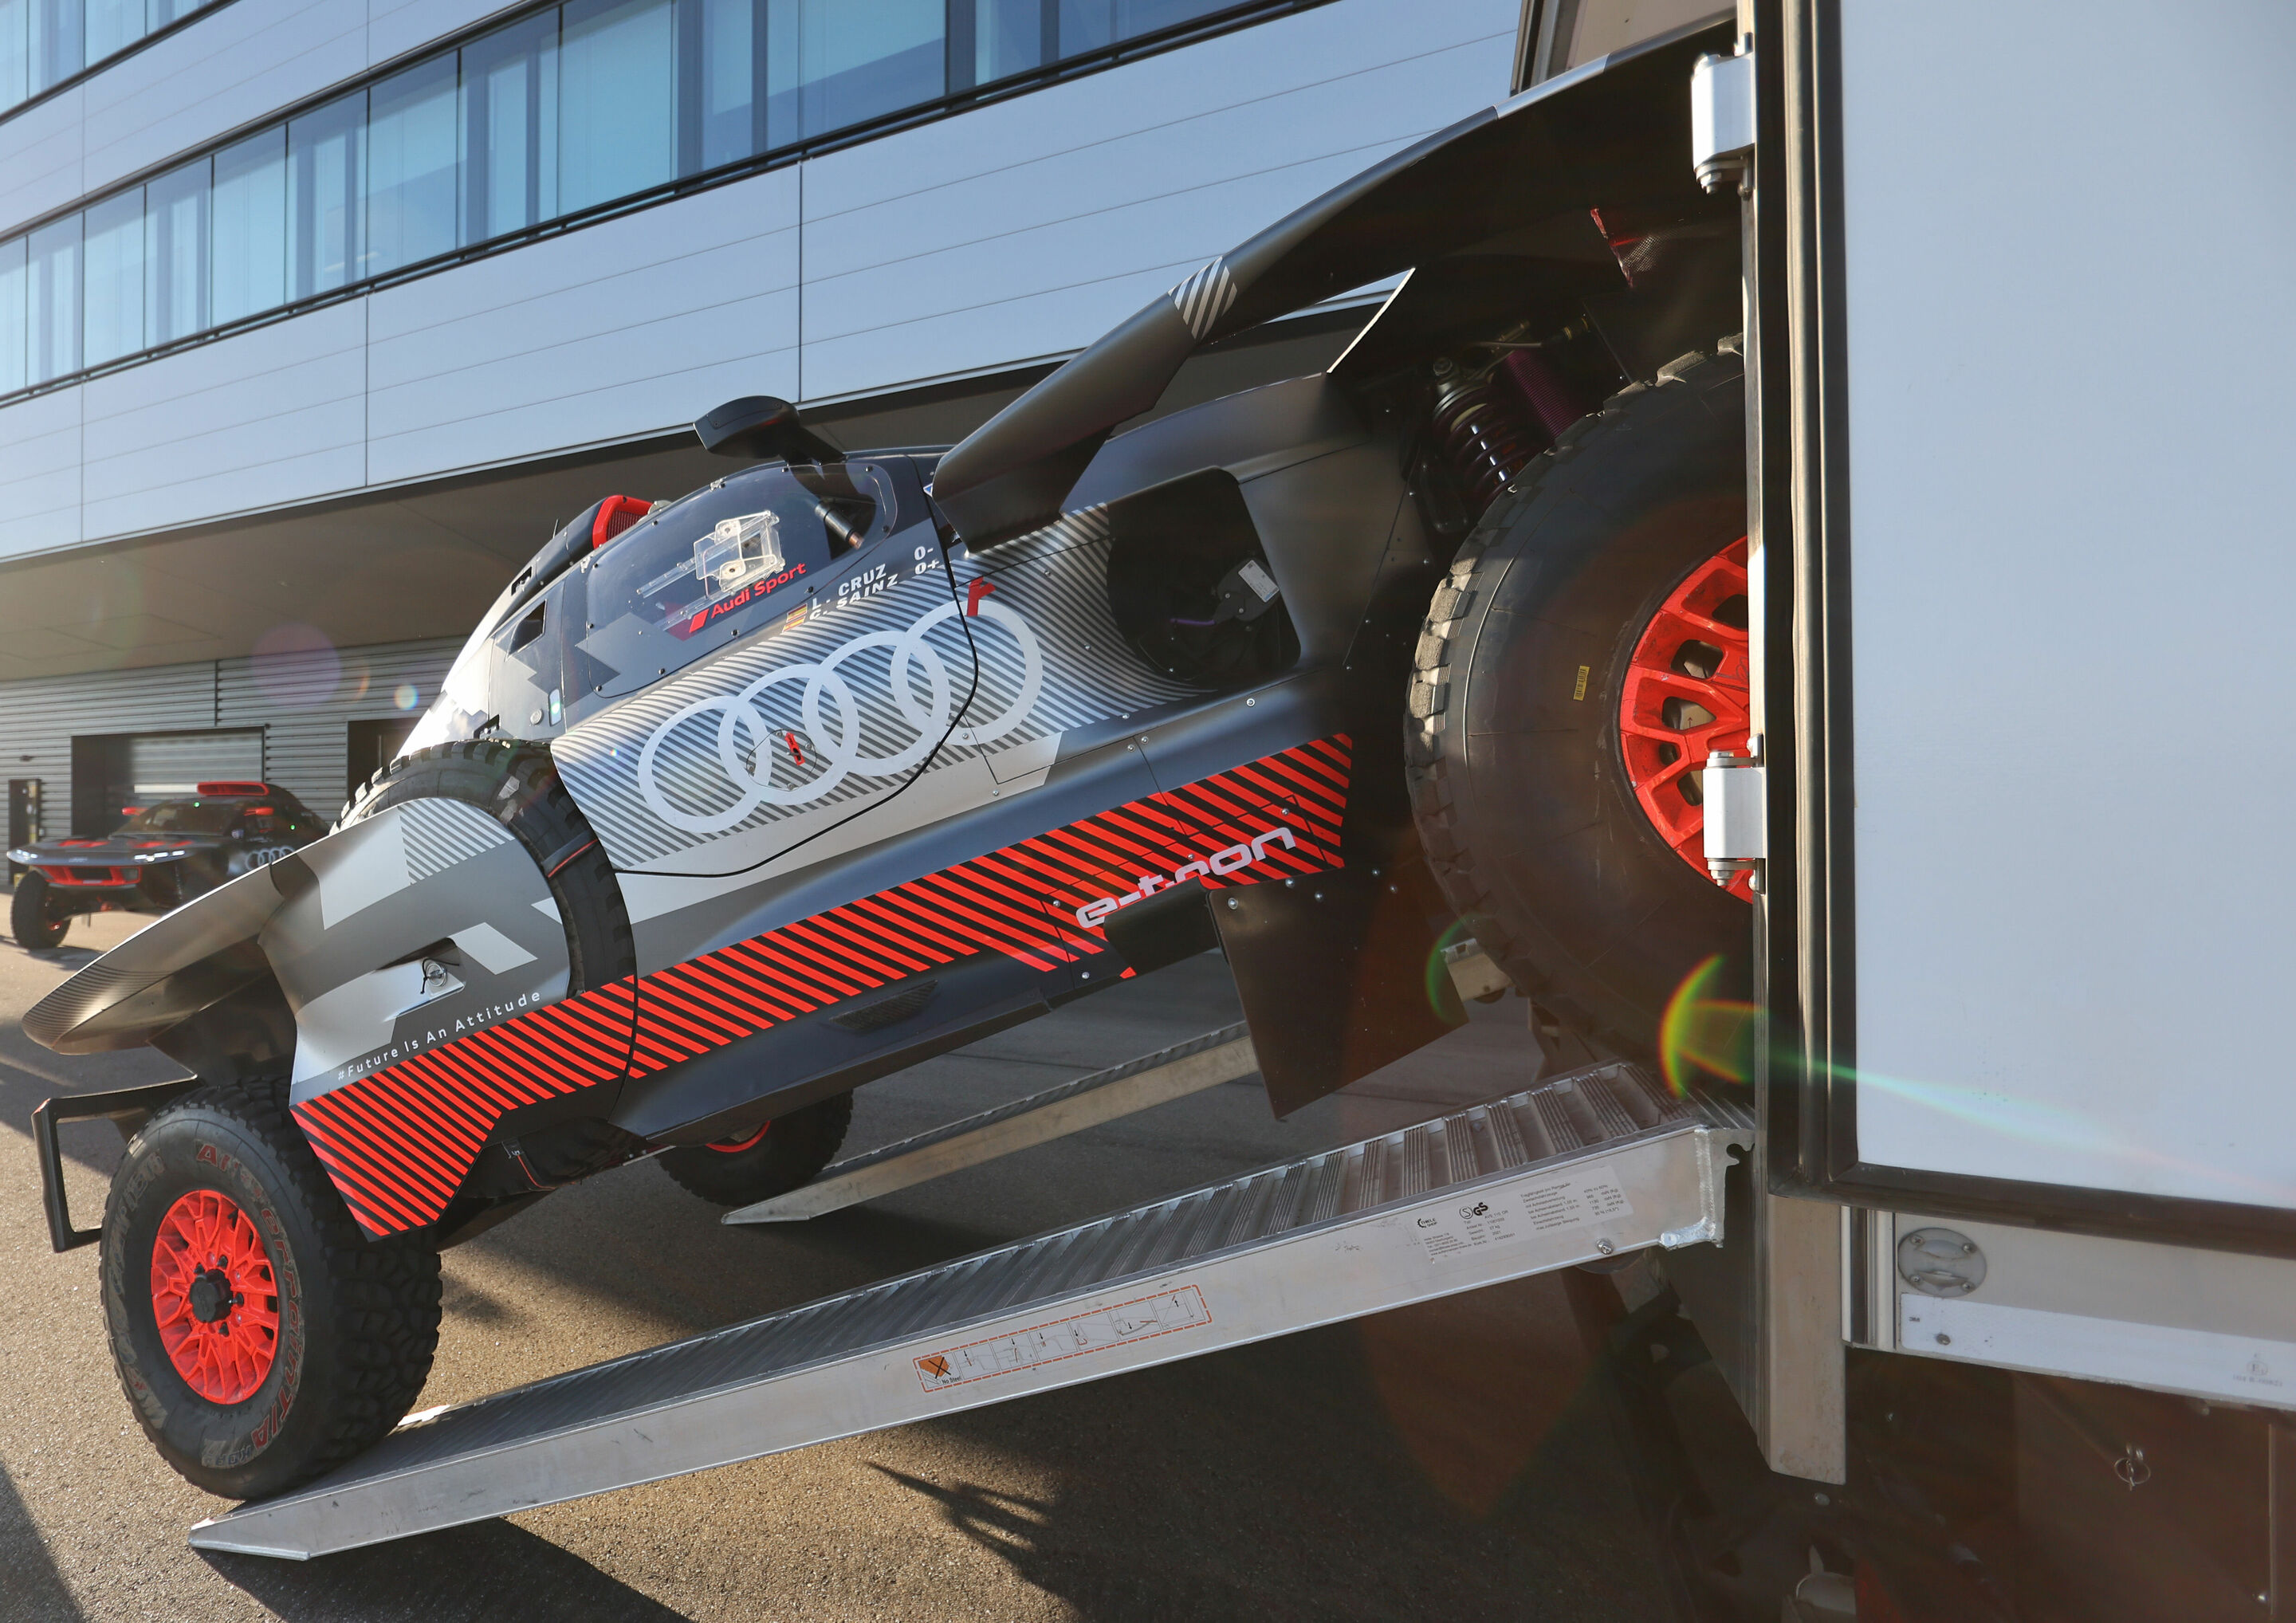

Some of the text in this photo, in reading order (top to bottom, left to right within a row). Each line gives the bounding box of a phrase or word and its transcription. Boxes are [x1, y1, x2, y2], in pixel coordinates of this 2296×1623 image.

[710, 563, 807, 619] Audi Sport
[835, 573, 899, 608] SAINZ
[838, 563, 887, 597] CRUZ
[337, 990, 541, 1081] #Future Is An Attitude
[1473, 1202, 1488, 1216] GS
